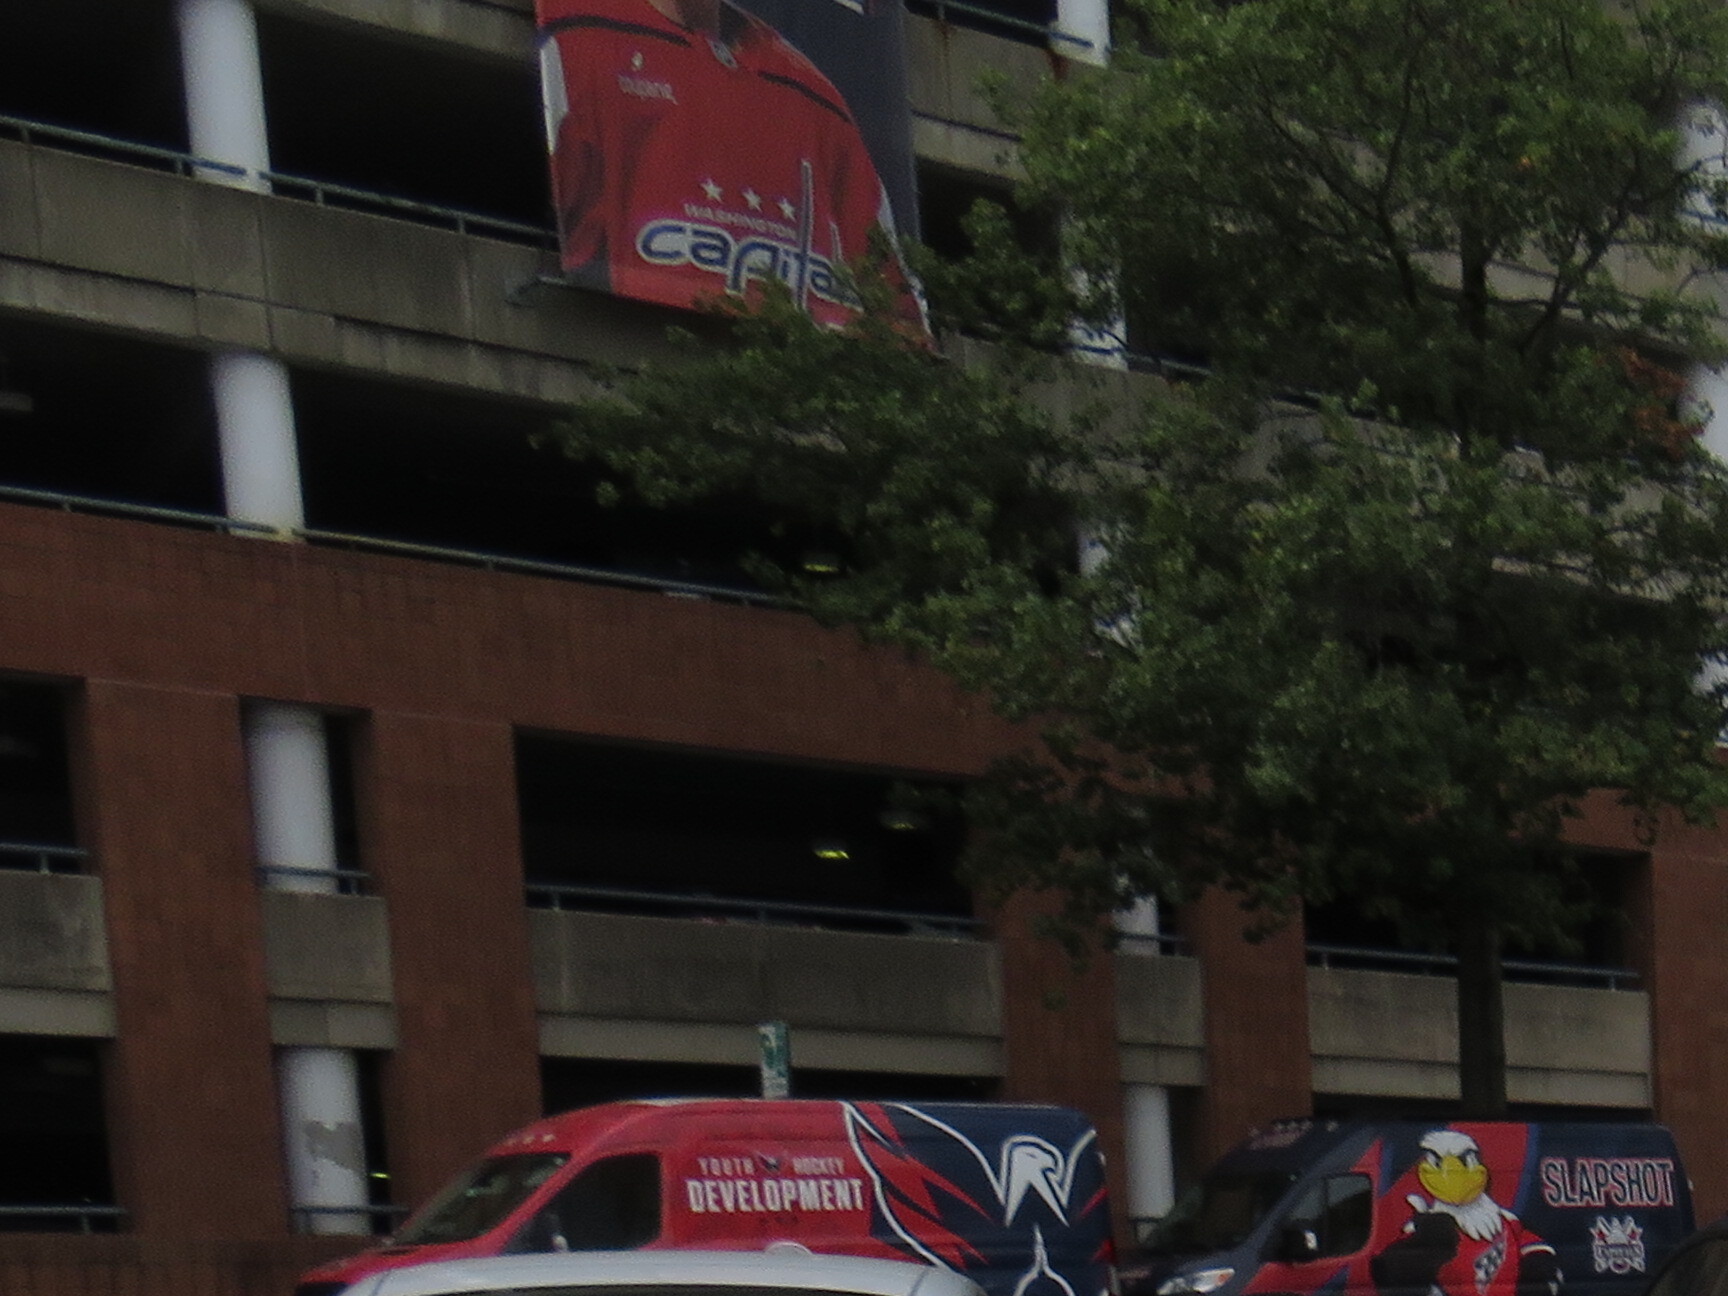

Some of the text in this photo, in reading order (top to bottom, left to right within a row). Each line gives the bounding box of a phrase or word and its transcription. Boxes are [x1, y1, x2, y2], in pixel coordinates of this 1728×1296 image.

[636, 160, 866, 312] capita
[698, 1157, 845, 1176] YOUTH HOCKEY
[1540, 1157, 1675, 1208] SLAPSHOT
[685, 1178, 864, 1213] DEVELOPMENT
